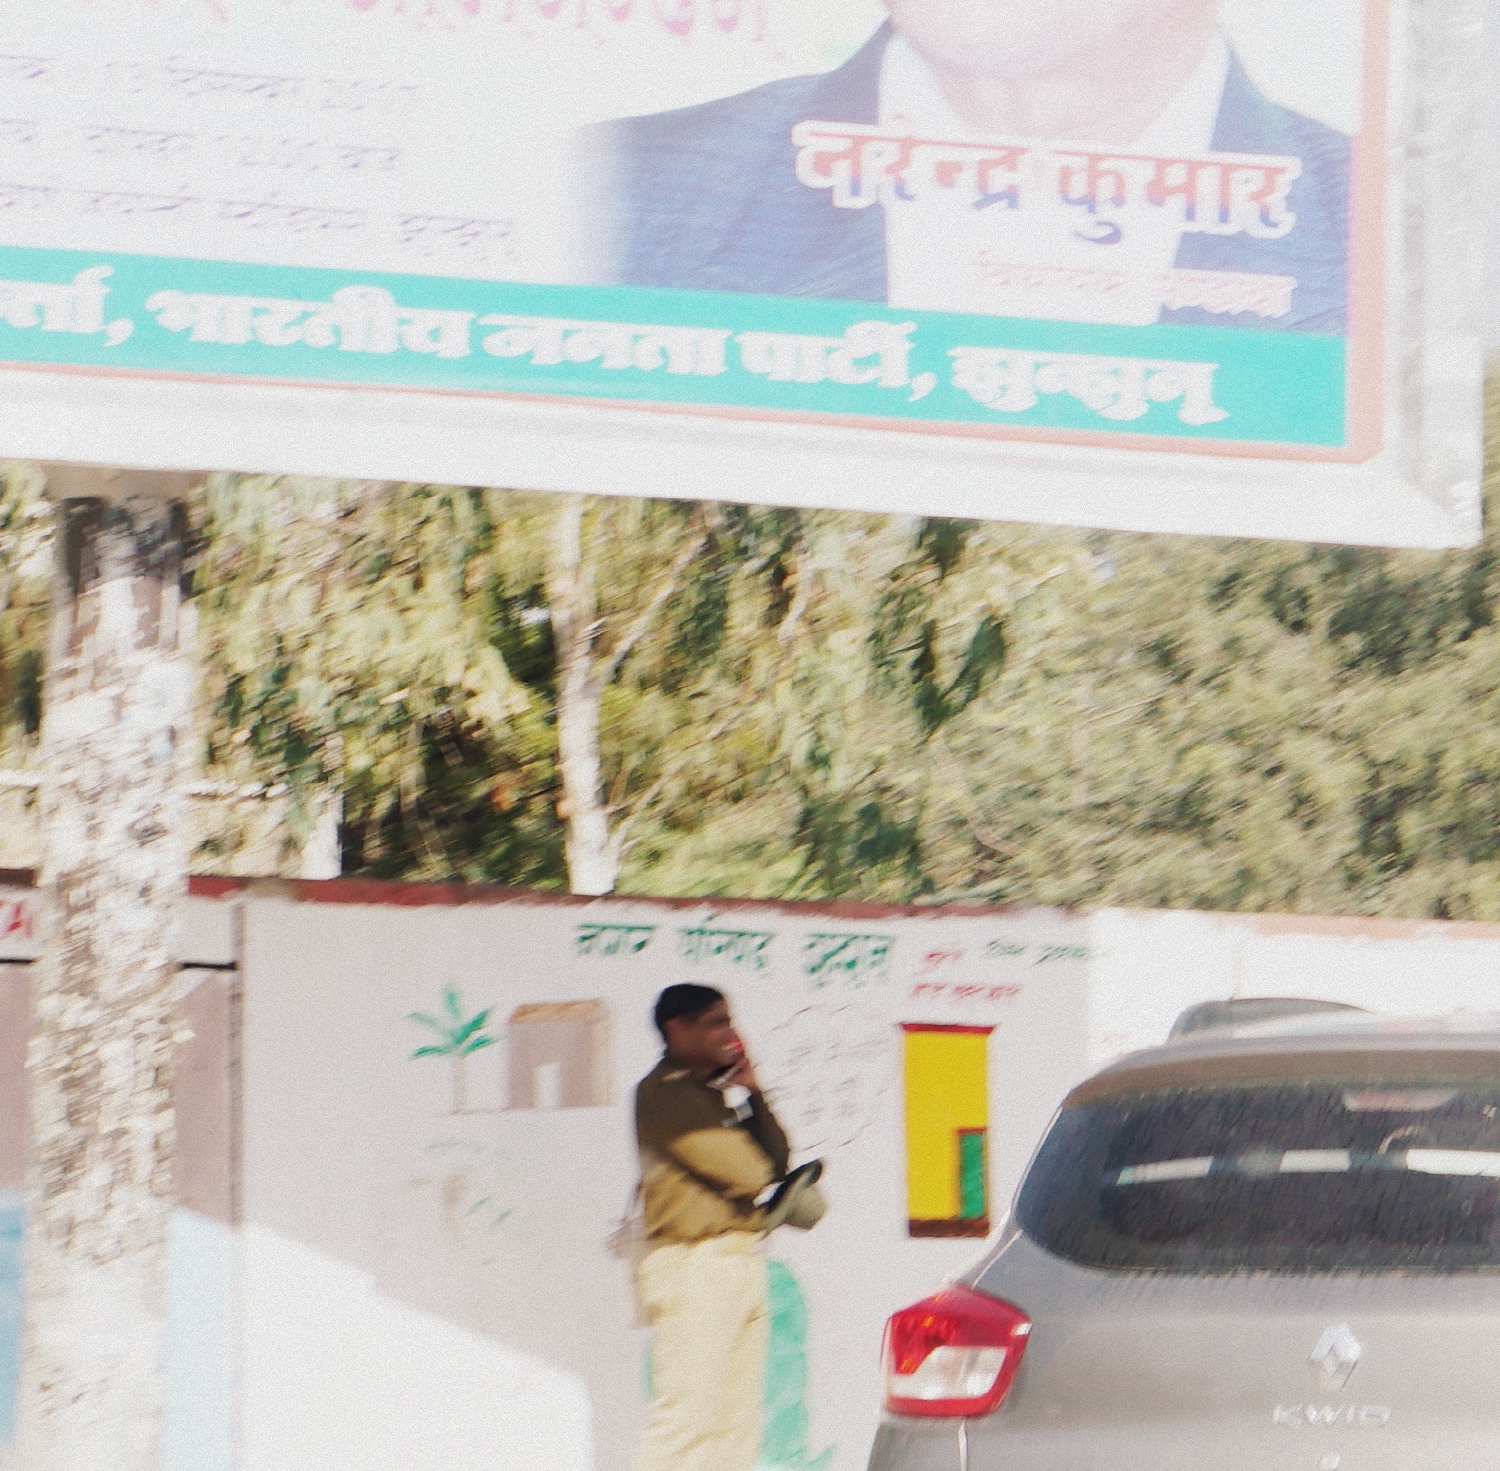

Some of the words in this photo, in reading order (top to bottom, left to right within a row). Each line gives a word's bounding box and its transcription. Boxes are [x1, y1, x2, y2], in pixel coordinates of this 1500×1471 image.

[794, 112, 1029, 214] नरेन्द्र
[1051, 138, 1300, 247] कुमार
[143, 283, 473, 361] भारतीय
[480, 312, 726, 379] जनता
